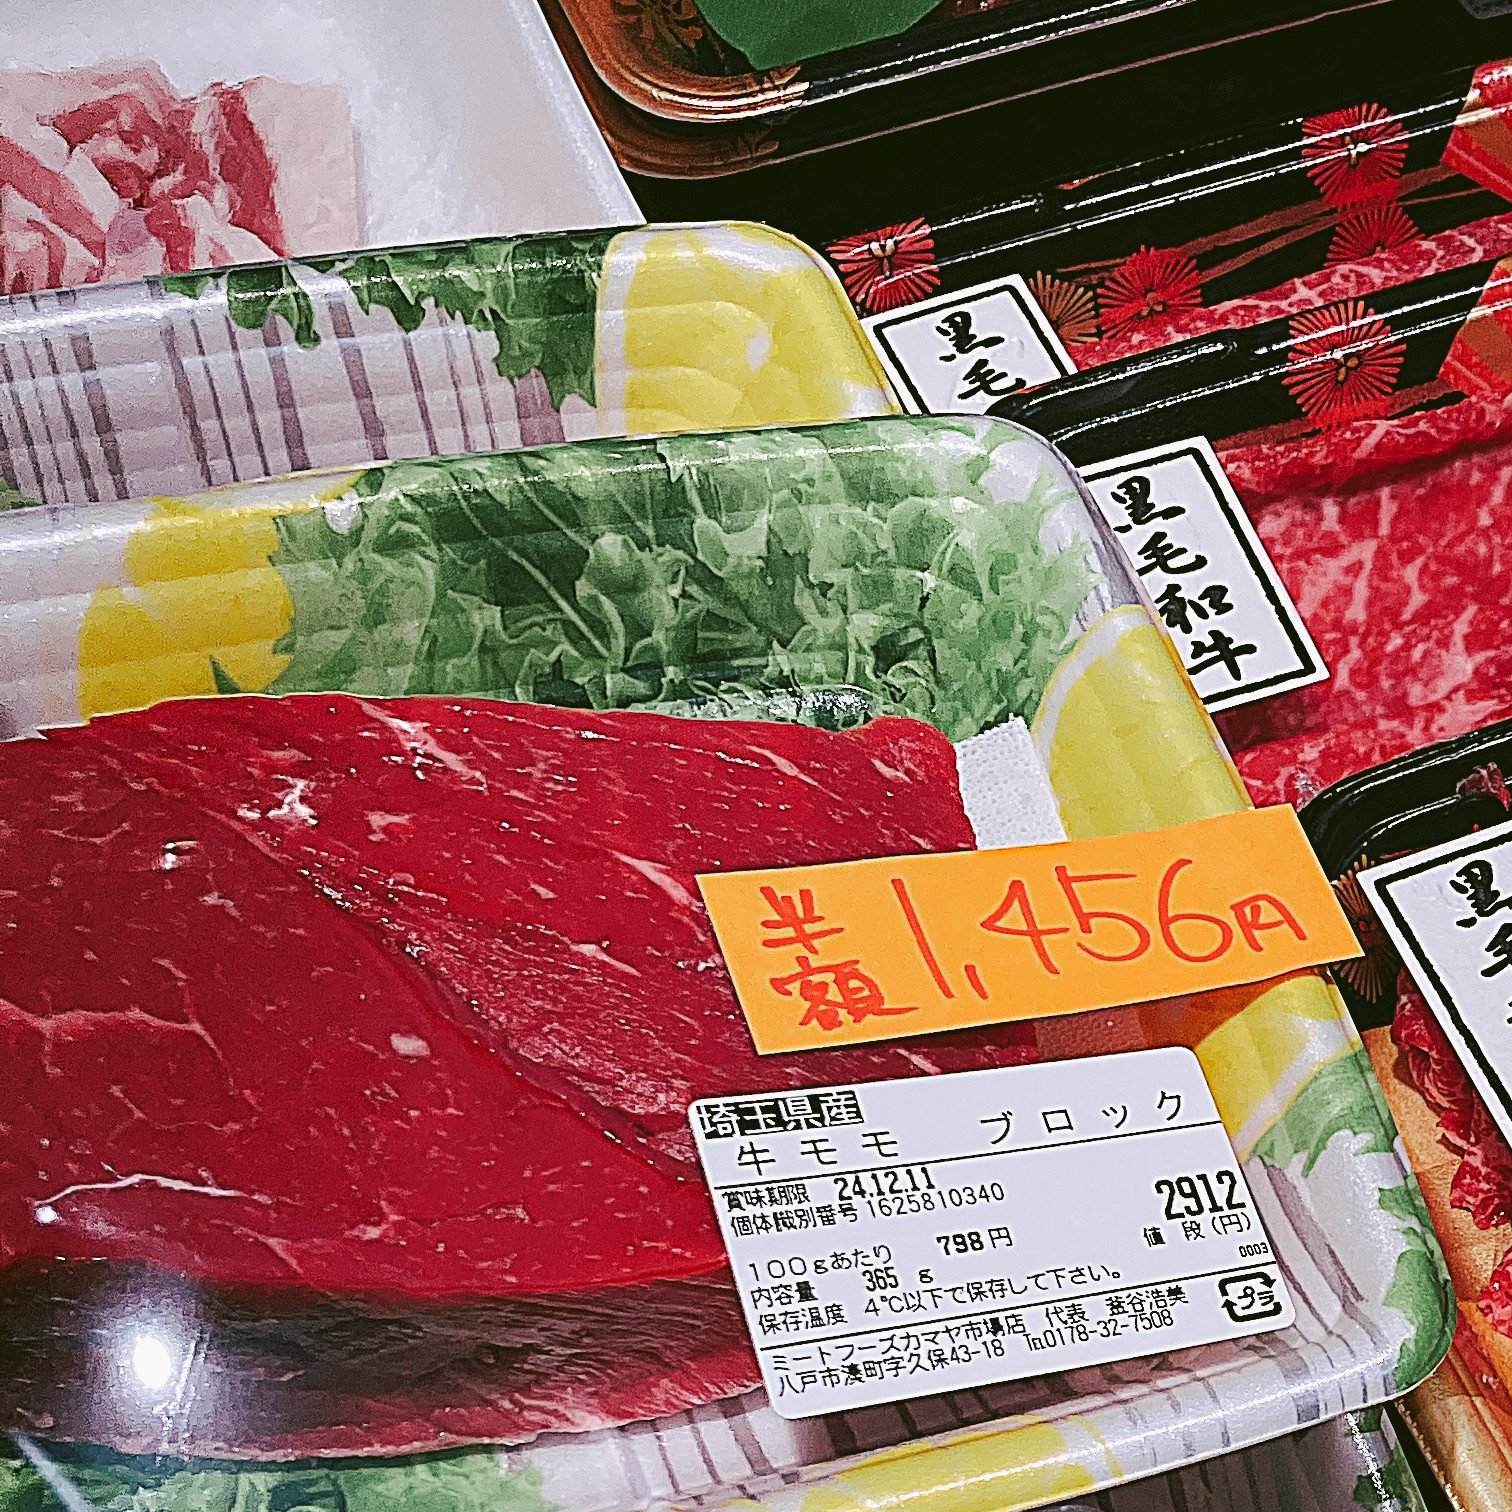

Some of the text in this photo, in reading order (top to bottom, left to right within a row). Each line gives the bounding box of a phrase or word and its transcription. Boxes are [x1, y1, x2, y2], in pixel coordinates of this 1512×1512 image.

[1110, 476, 1257, 681] 黒毛和牛
[891, 858, 1307, 1000] 1,456円
[760, 884, 919, 1031] 半額
[696, 1090, 864, 1139] 埼玉県産
[738, 1091, 1181, 1175] 牛モモ ブロック
[722, 1167, 935, 1212] 賞味期限 24.12.11
[731, 1183, 1004, 1237] 個体識別番号 1625810340
[1155, 1170, 1246, 1220] 2912
[1239, 1242, 1268, 1257] 0003
[751, 1281, 818, 1309] 内容量
[759, 1304, 848, 1335] 保存温度
[773, 1314, 1026, 1375] ミートフーズカマヤ市場店
[1046, 1303, 1089, 1332] 代表
